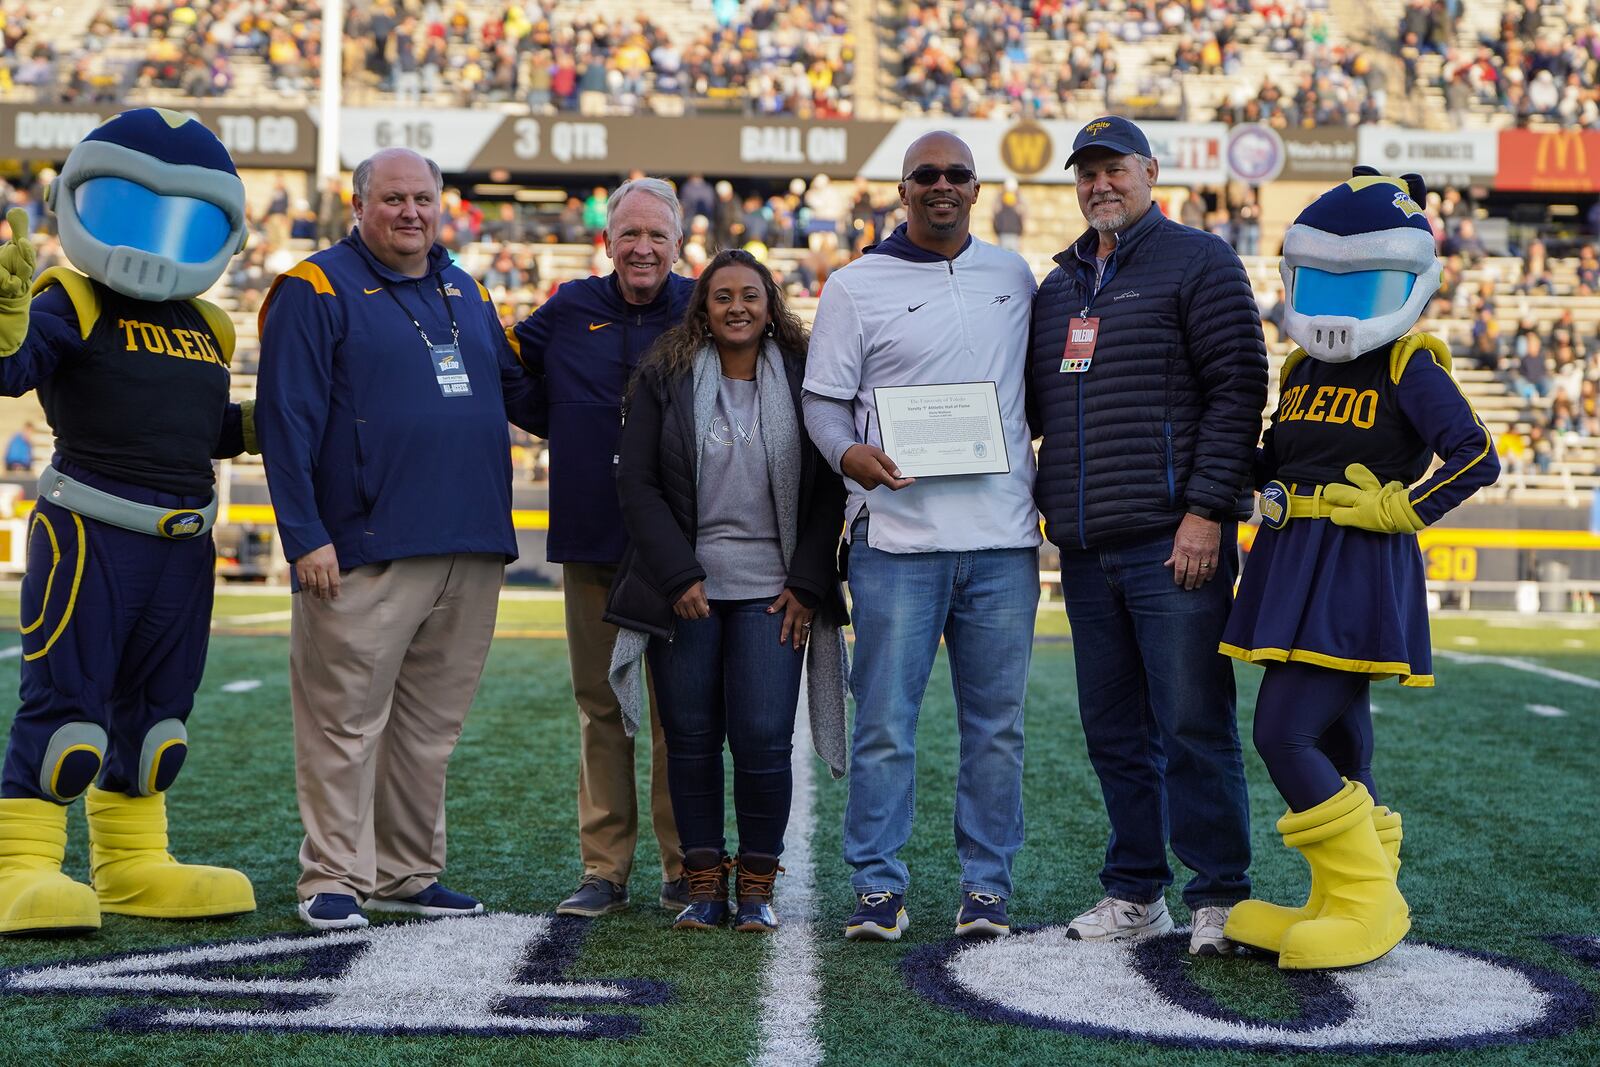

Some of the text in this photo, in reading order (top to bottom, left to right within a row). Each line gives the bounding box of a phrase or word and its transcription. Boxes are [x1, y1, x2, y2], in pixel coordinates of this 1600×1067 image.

[217, 117, 298, 154] TO GO
[513, 118, 608, 162] 3 QTR
[740, 126, 848, 163] BALL ON
[1007, 132, 1048, 169] W
[118, 318, 224, 367] TOLED
[1071, 329, 1095, 343] TOLEDO
[1426, 546, 1478, 581] 30
